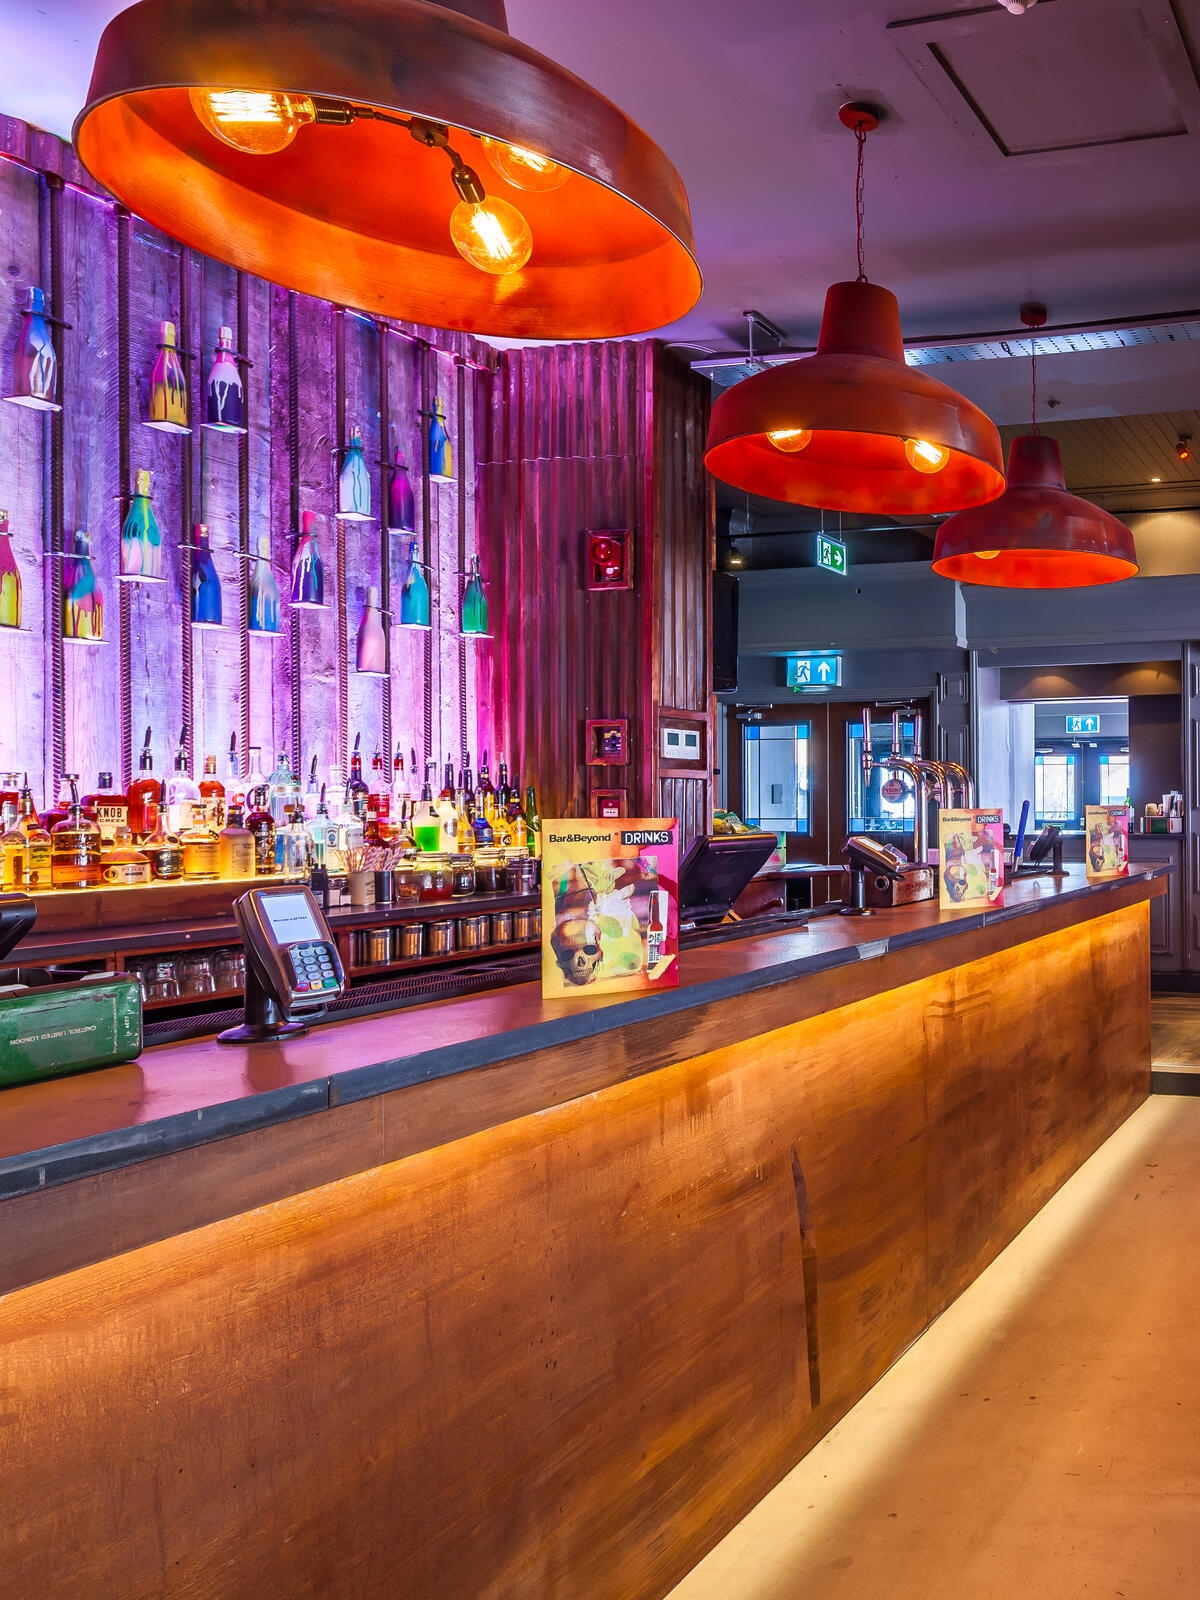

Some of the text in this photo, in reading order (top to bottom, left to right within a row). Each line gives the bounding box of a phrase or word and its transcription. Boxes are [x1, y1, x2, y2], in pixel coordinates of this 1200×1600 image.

[97, 807, 122, 818] KNOB
[977, 815, 999, 824] DRINKS
[549, 831, 669, 844] Bar&Beyond DRINKS
[10, 1025, 97, 1046] CASTROL LIMITED LONDON
